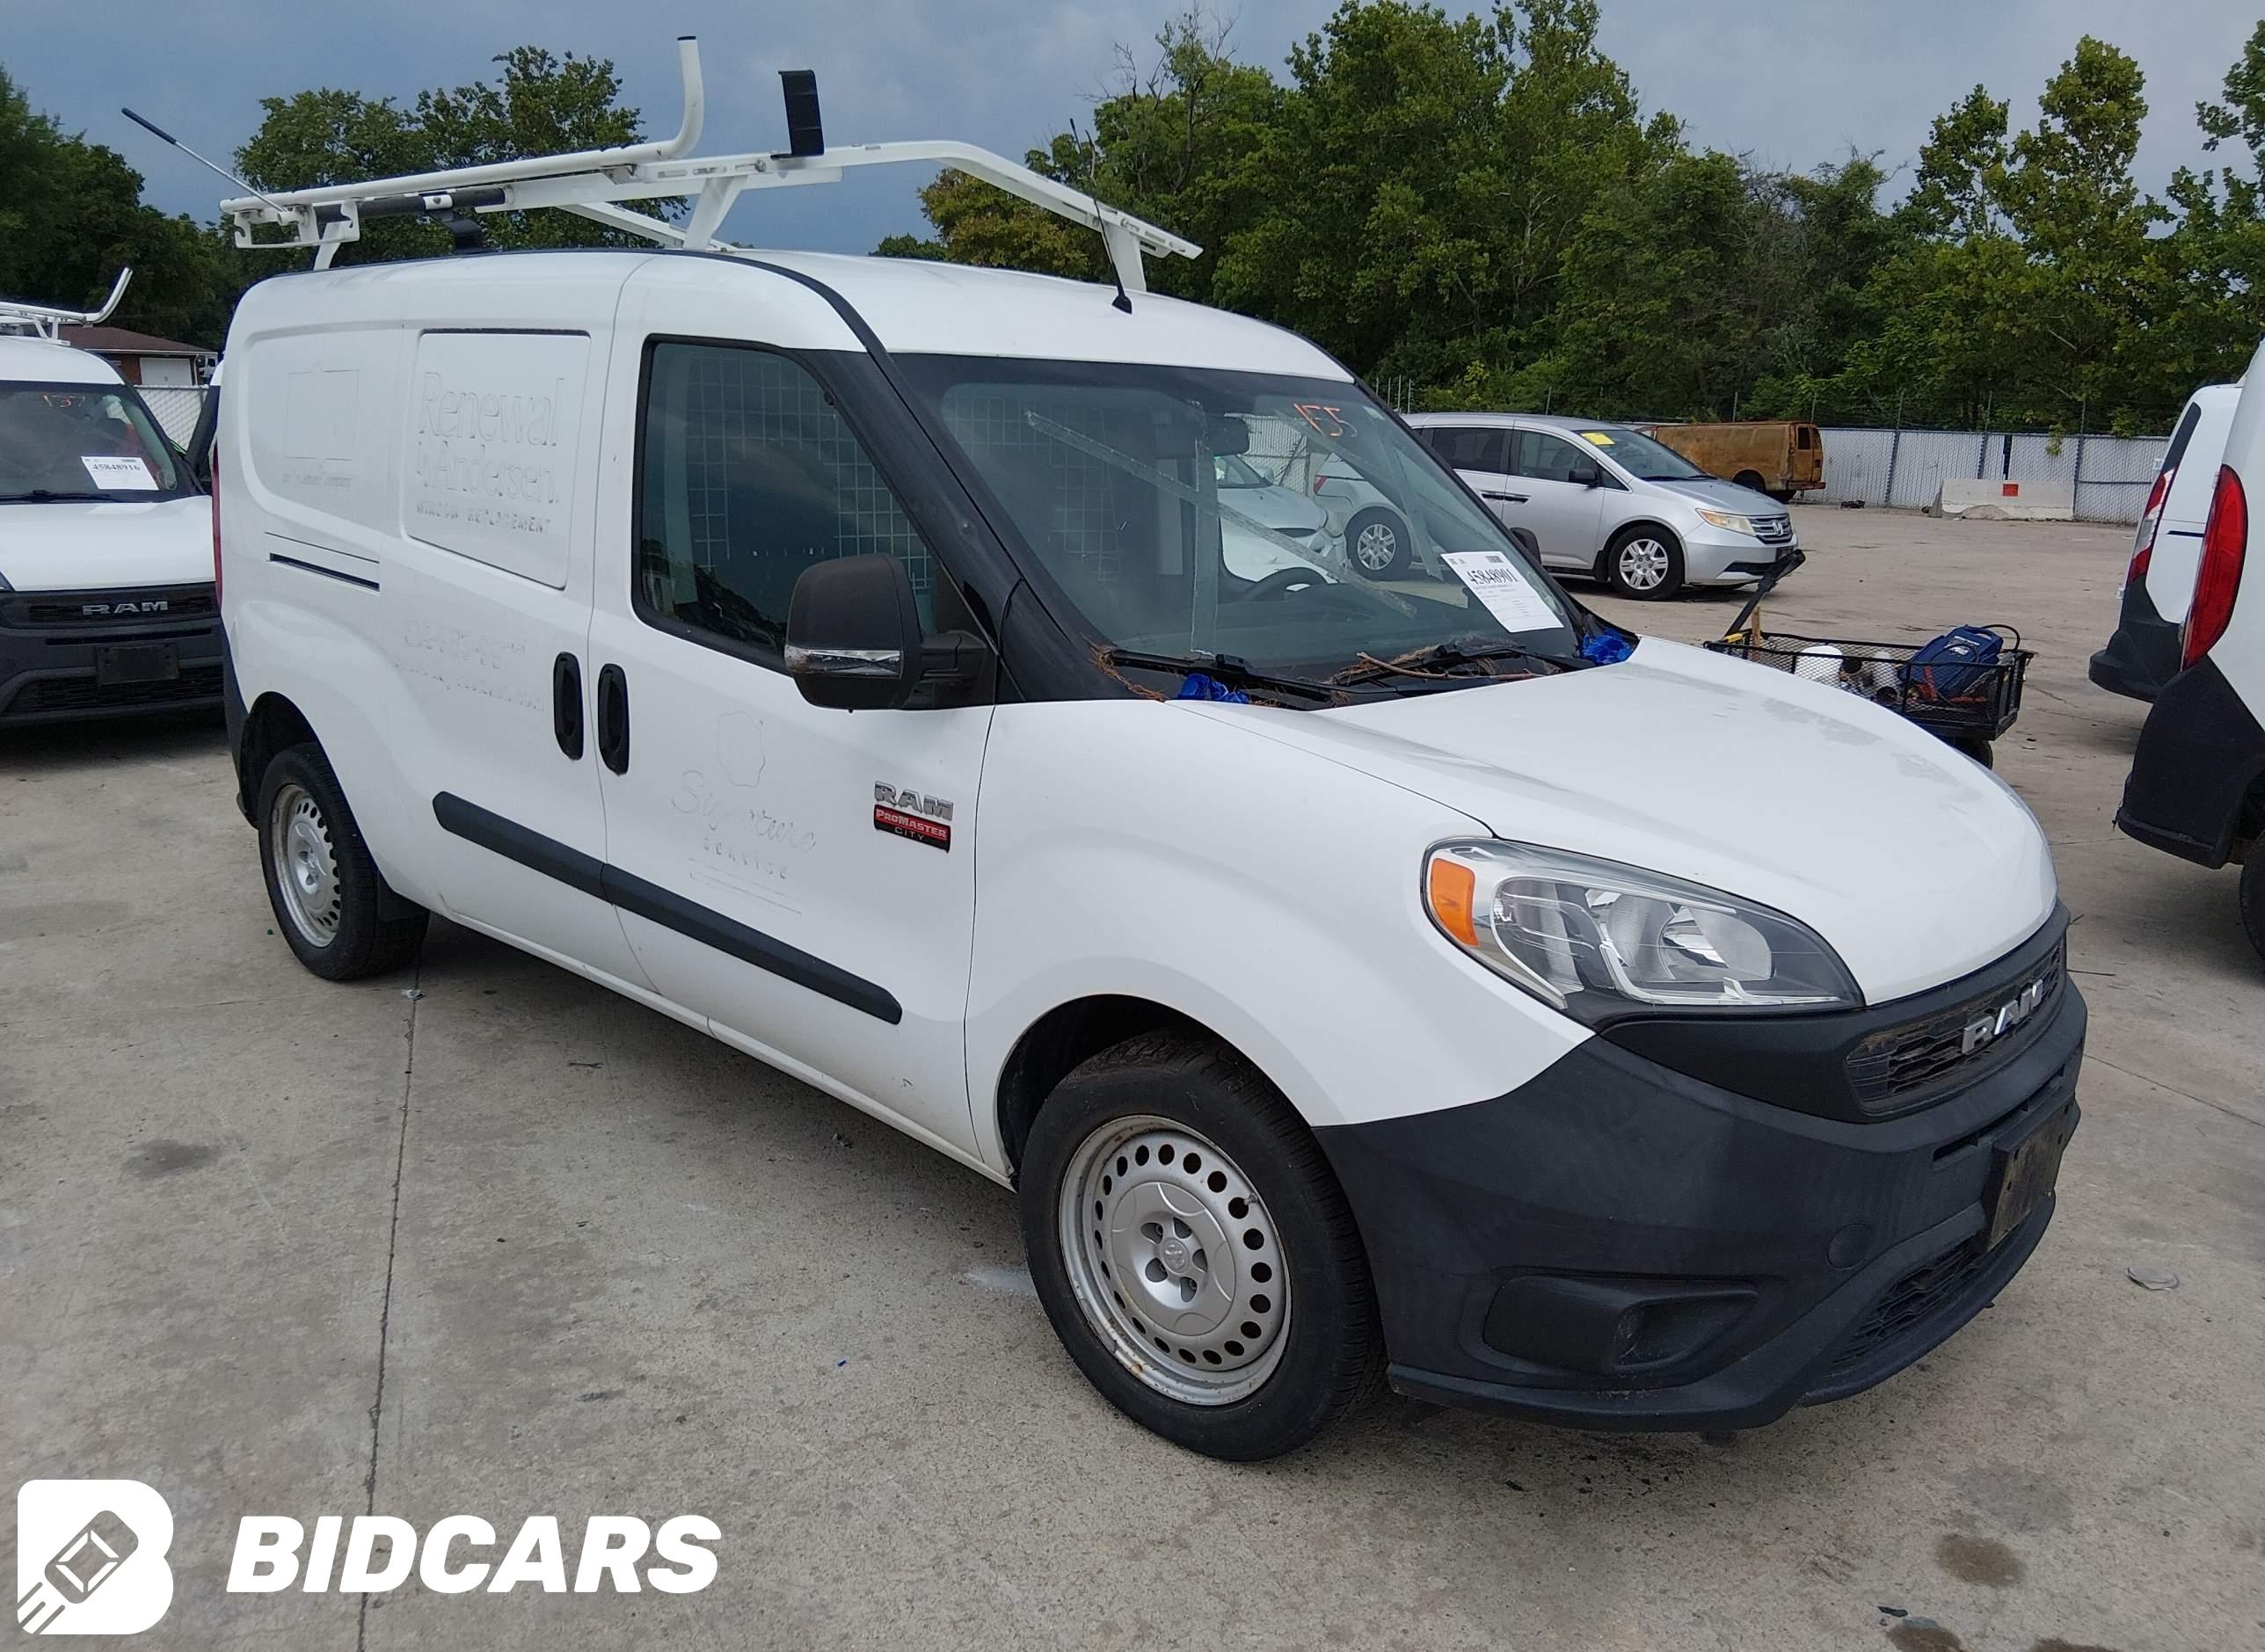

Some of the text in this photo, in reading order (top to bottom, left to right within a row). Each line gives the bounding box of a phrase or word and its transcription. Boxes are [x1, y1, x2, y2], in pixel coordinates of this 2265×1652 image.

[1466, 567, 1519, 586] 45848901
[82, 600, 169, 615] RAM
[874, 780, 954, 822] RAM
[893, 826, 925, 841] CITY
[1961, 978, 2044, 1056] RAM
